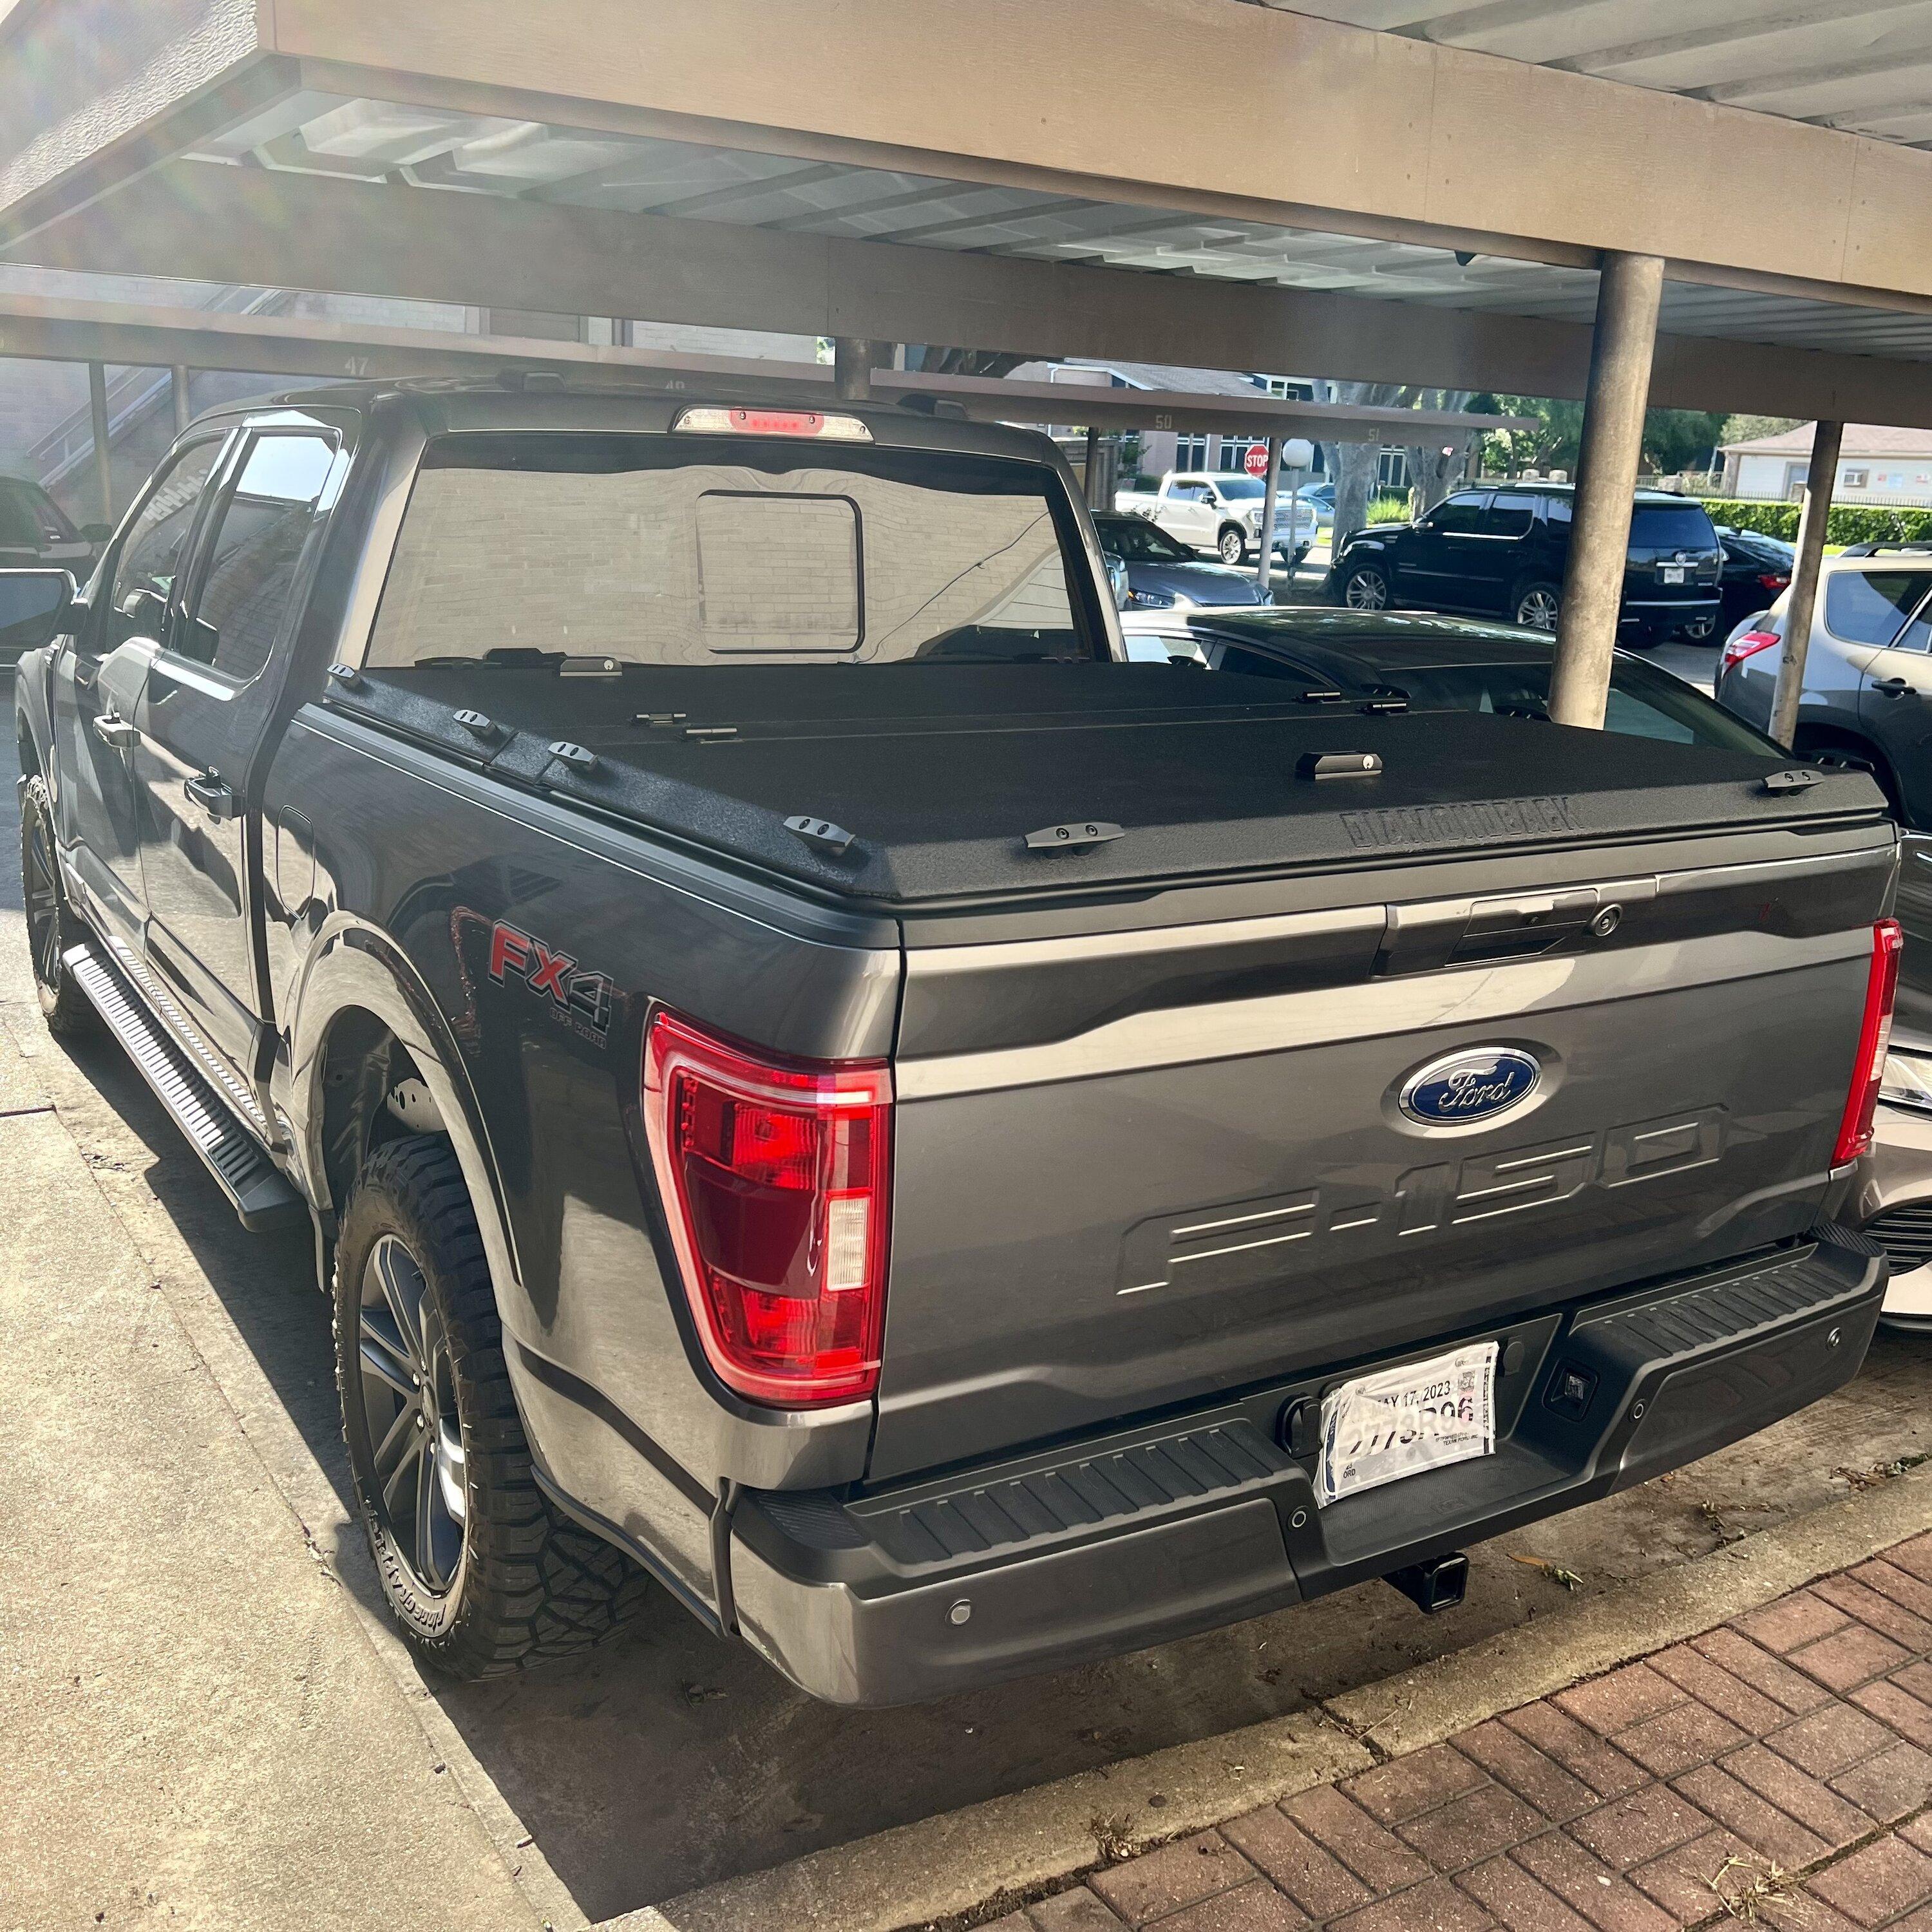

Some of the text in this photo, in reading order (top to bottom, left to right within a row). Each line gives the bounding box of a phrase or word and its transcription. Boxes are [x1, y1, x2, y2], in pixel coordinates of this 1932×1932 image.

[1156, 415, 1172, 430] 50
[1247, 455, 1269, 468] STOP
[488, 919, 614, 1036] FX4
[1438, 1065, 1515, 1112] Ford
[1423, 1380, 1451, 1402] 2023
